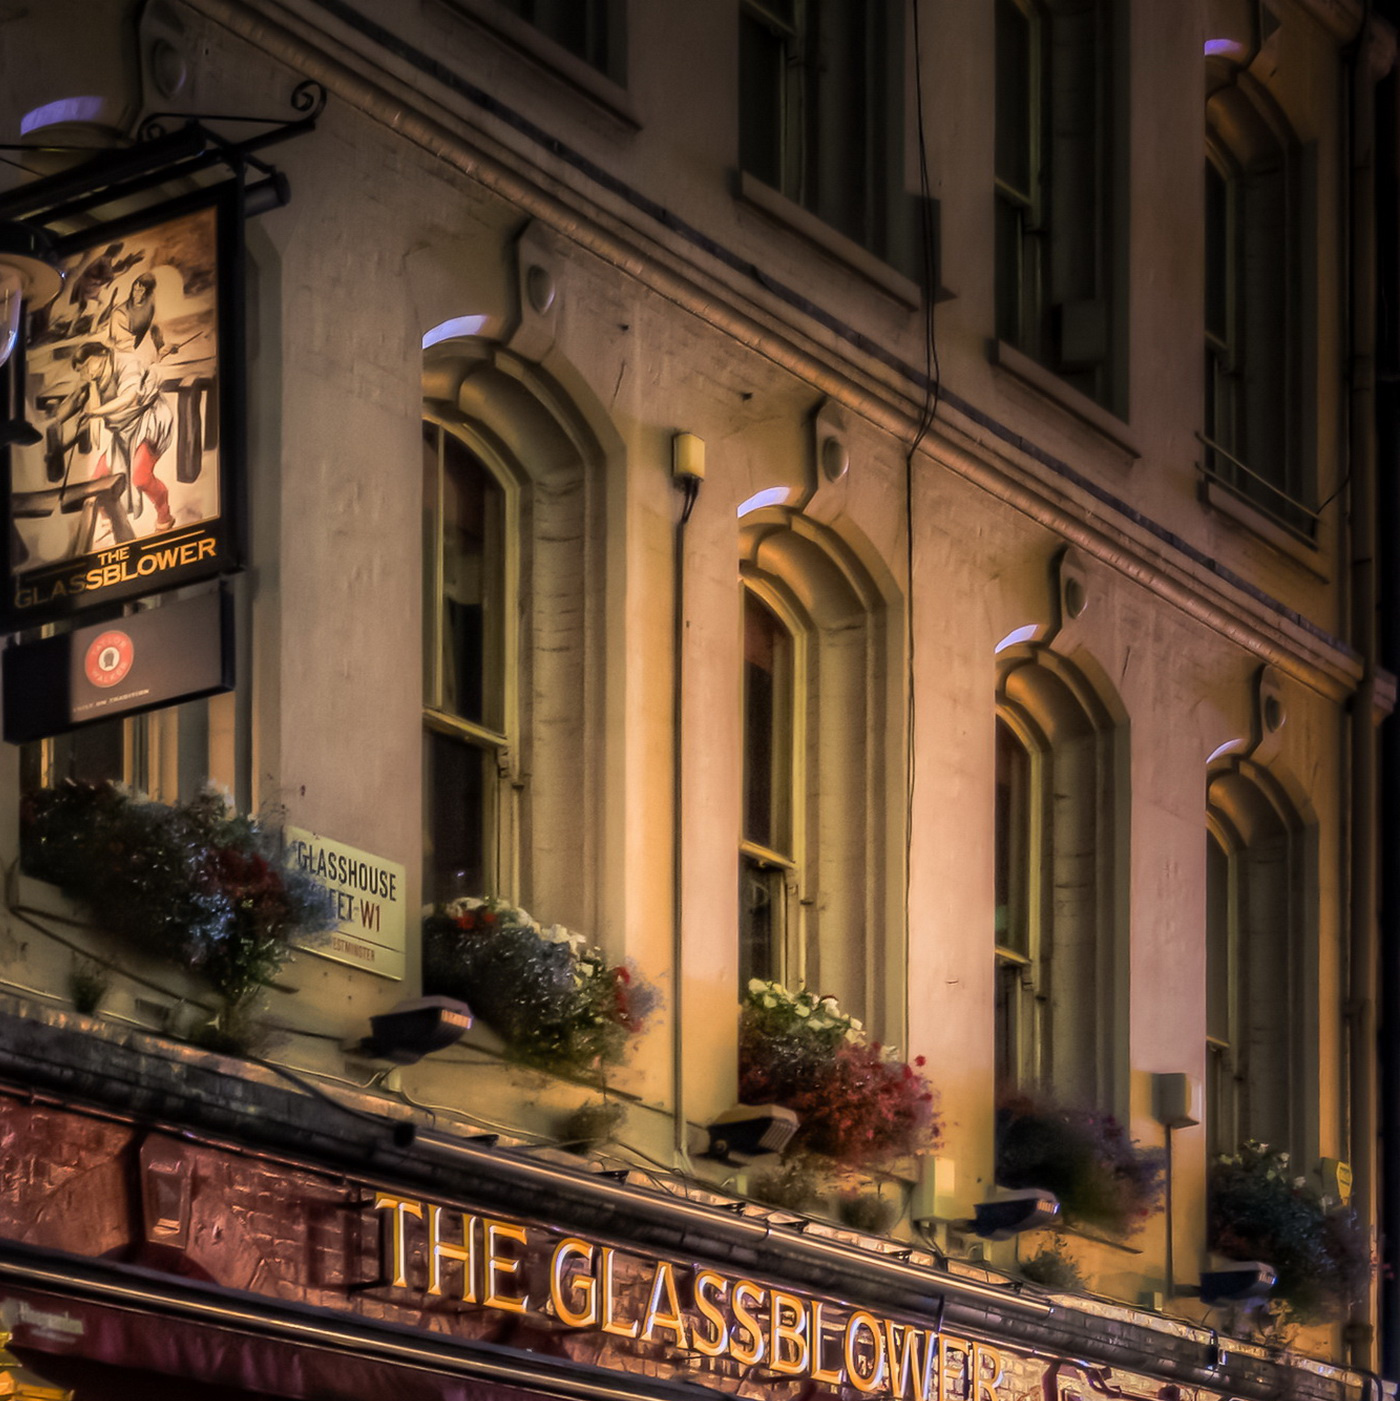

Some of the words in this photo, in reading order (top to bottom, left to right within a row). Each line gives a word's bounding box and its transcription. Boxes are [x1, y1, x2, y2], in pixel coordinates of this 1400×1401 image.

[14, 537, 218, 609] GLASSBLOWER
[98, 546, 131, 566] THE
[296, 840, 397, 902] GLASSHOUSE
[360, 899, 381, 933] W1
[332, 936, 376, 963] ESTMINSTER
[375, 1191, 530, 1315] THE
